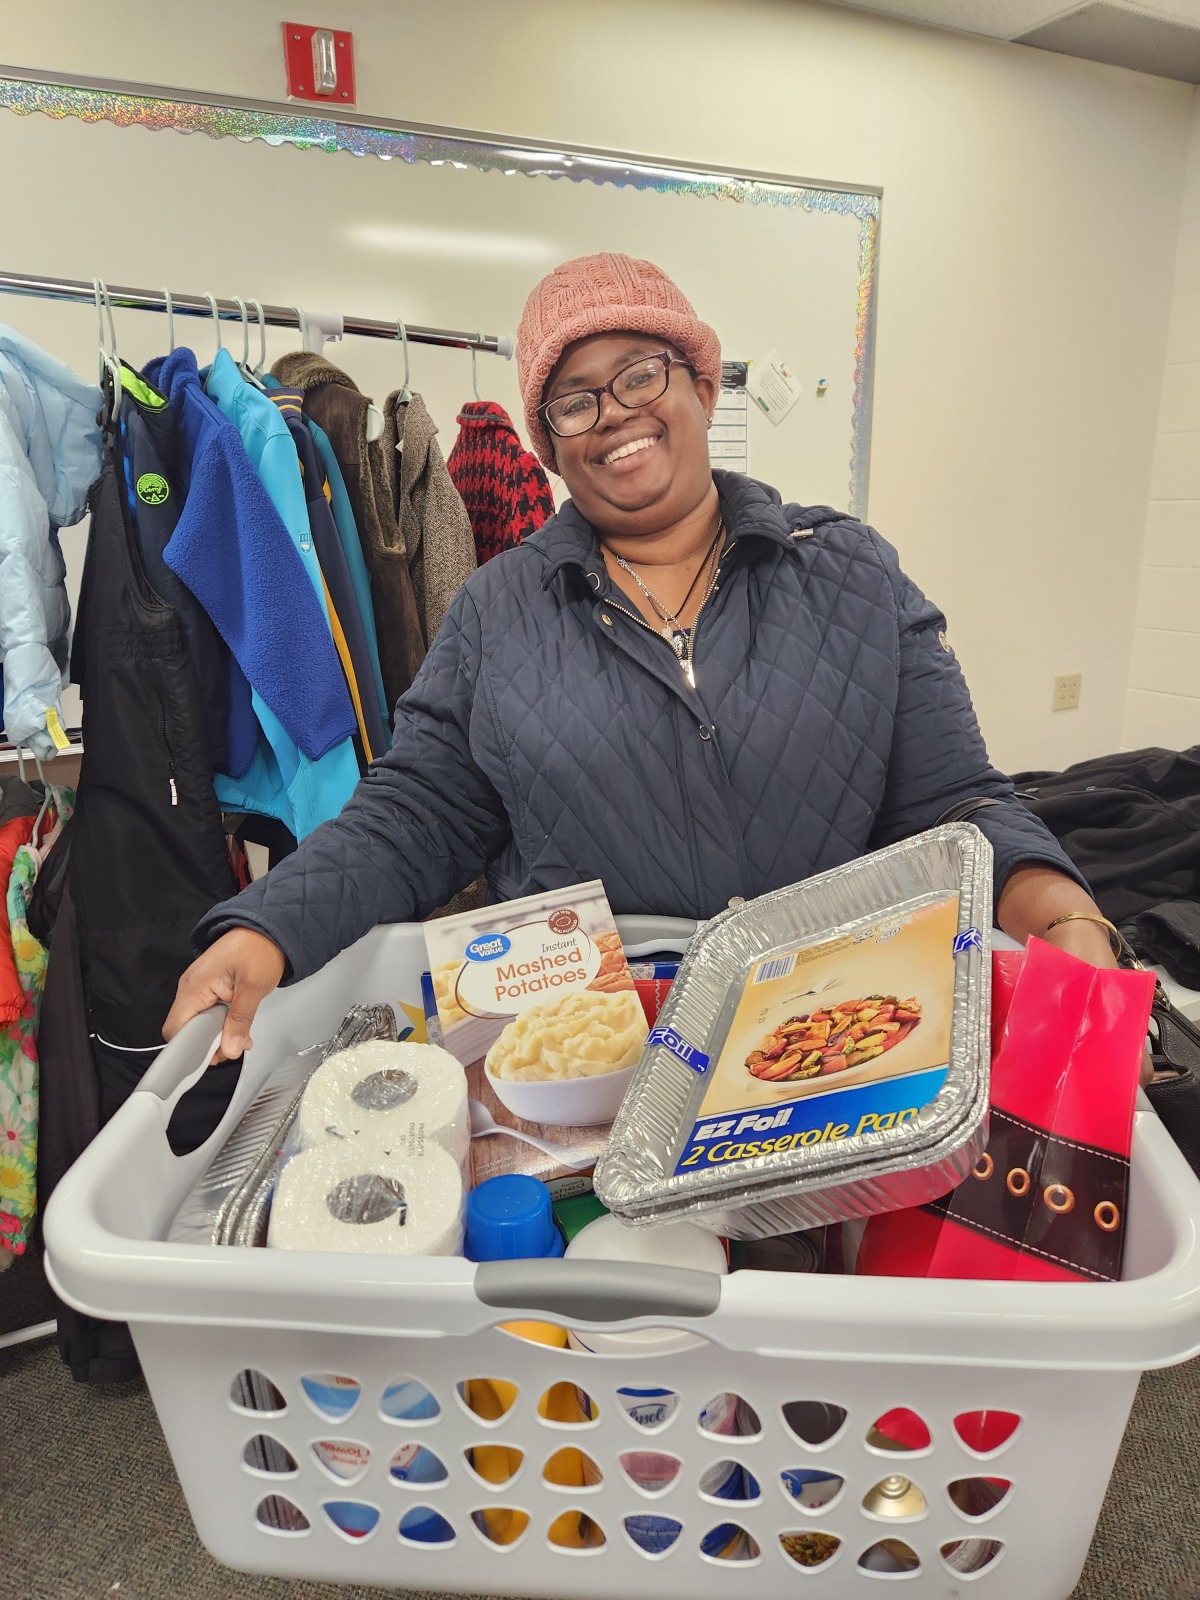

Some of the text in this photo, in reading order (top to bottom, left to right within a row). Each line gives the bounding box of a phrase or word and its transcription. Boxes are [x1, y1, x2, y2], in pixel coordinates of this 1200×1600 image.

[469, 937, 503, 954] Great
[478, 945, 504, 958] Value
[542, 937, 578, 954] Instant
[496, 947, 583, 983] Mashed
[494, 967, 588, 1002] Potatoes
[645, 1027, 695, 1062] Foil
[680, 1107, 919, 1166] 2 Casserole Pan
[693, 1107, 794, 1142] EZ Foil
